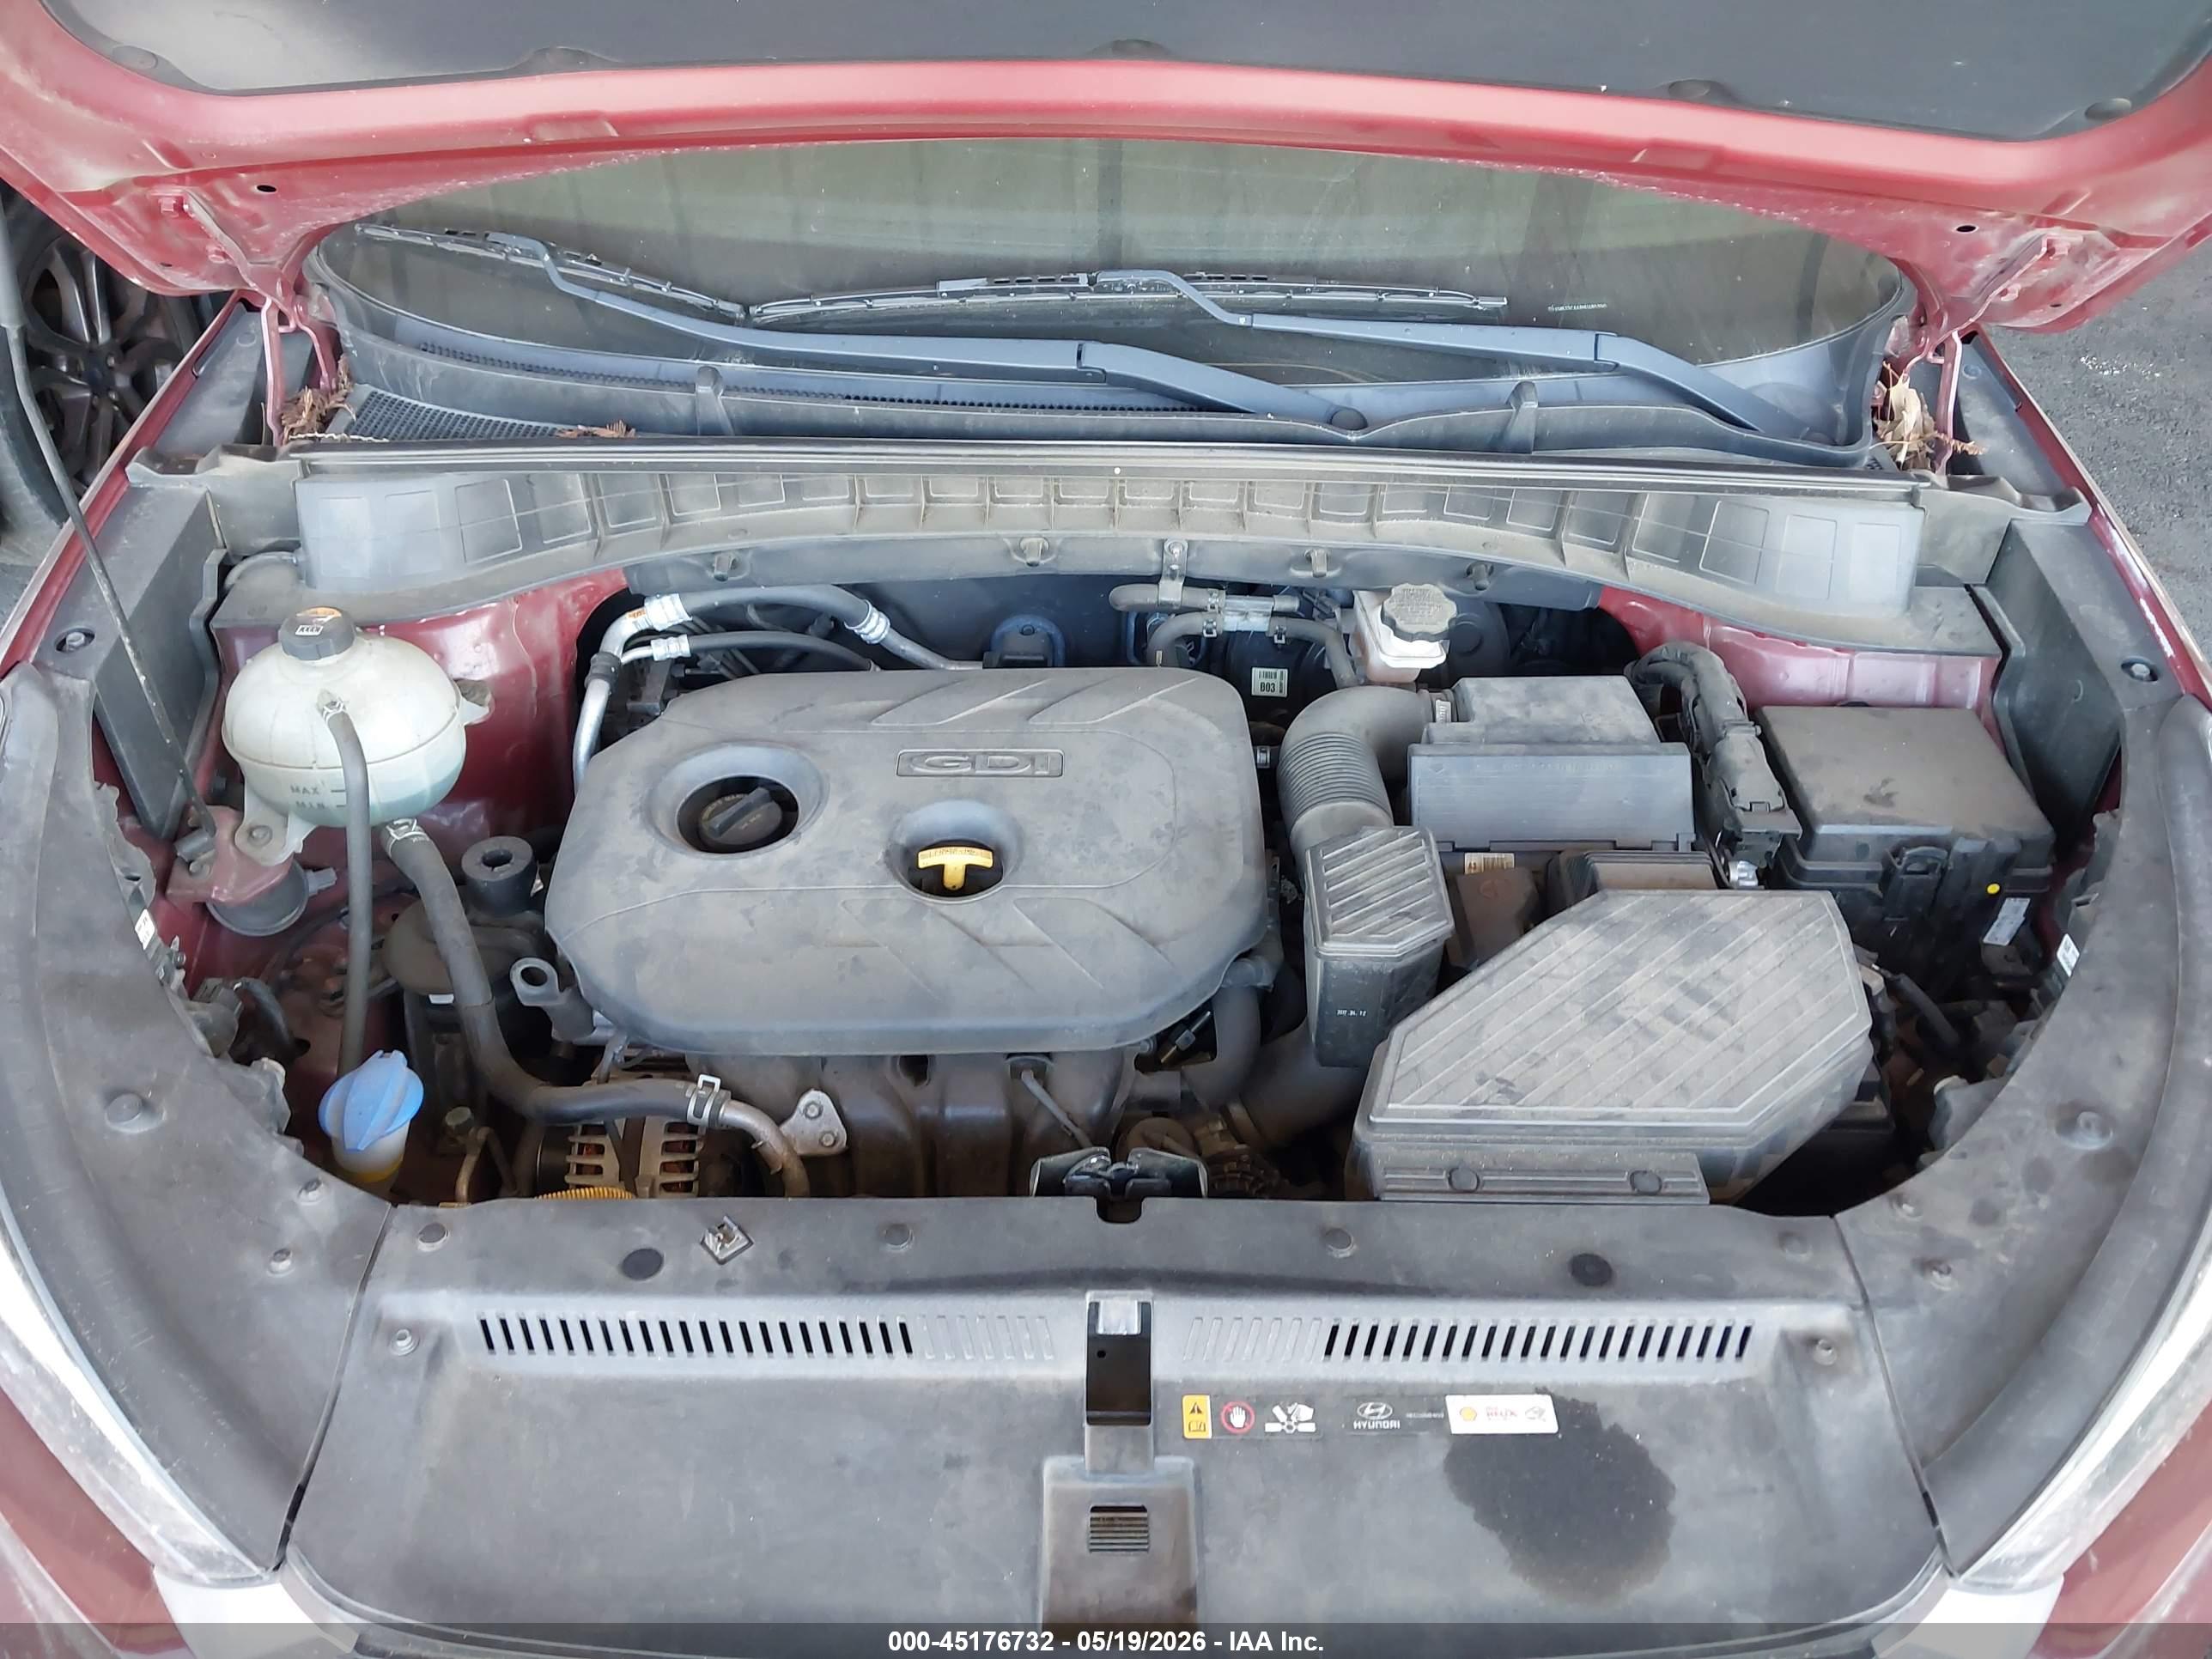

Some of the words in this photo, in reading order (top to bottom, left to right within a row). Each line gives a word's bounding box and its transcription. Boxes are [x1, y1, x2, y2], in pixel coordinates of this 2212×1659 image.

[909, 753, 1051, 775] GDI
[289, 784, 319, 795] MAX
[1352, 1419, 1401, 1430] HYUNDAI
